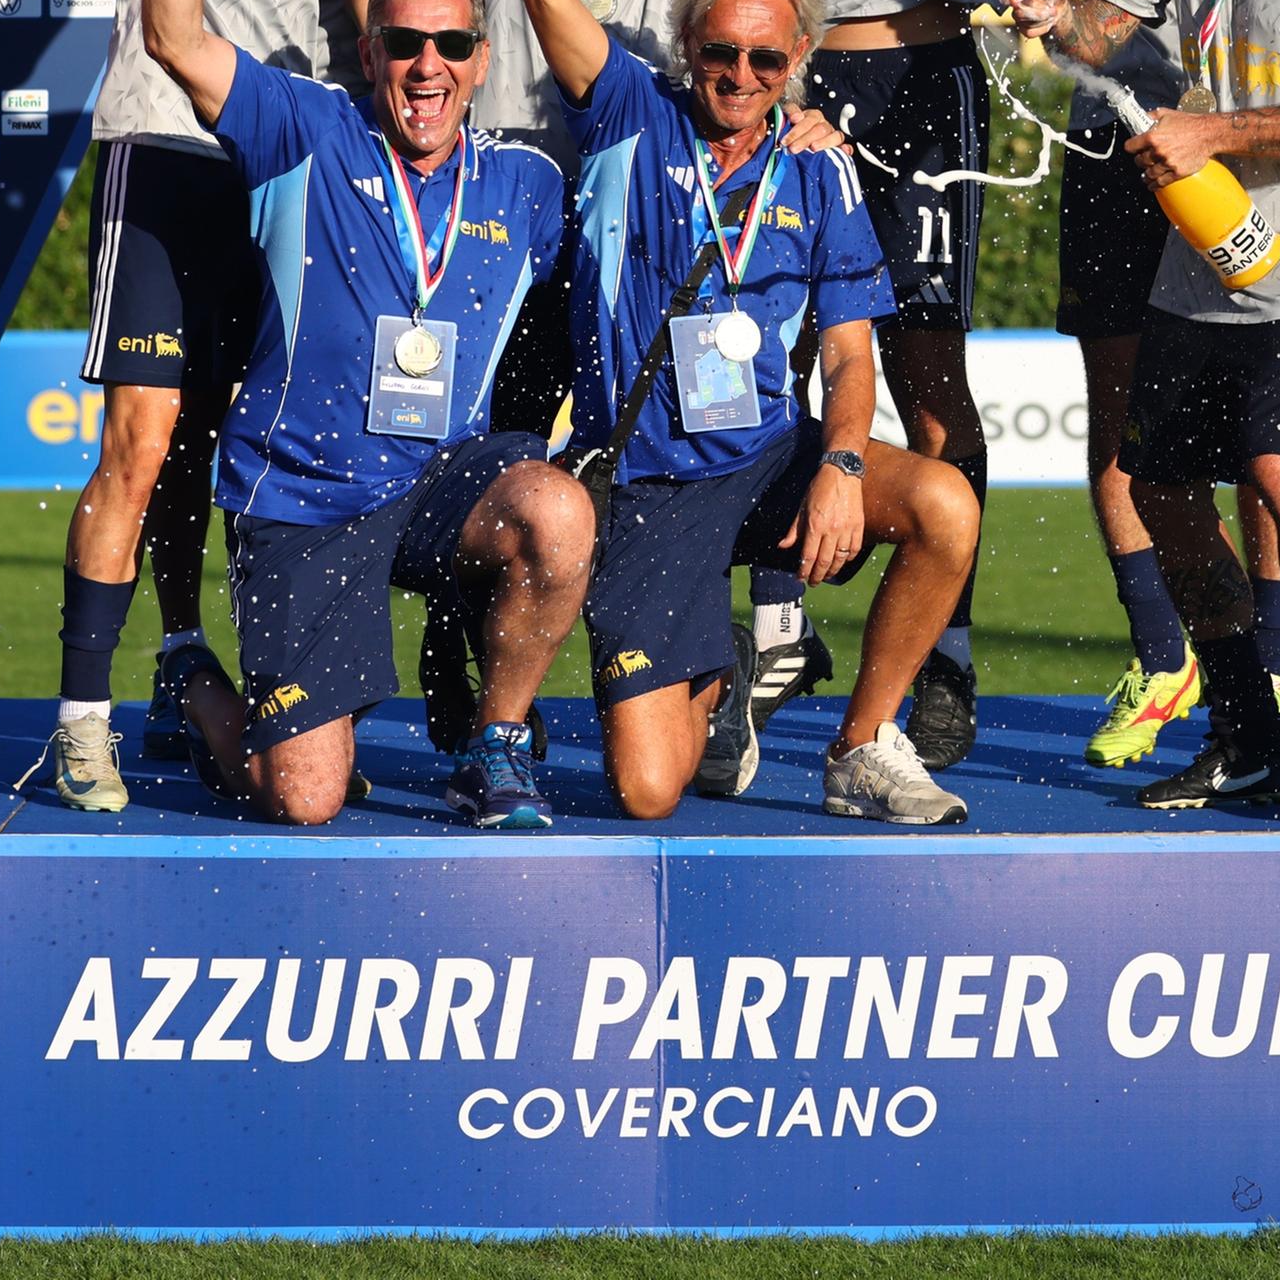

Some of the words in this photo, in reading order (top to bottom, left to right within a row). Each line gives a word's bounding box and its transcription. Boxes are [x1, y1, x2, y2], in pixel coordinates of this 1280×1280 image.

[8, 96, 42, 108] Fileni
[460, 220, 488, 241] eni
[916, 206, 953, 264] 11
[118, 334, 153, 354] eni
[45, 957, 534, 1062] AZZURRI
[572, 955, 1068, 1060] PARTNER
[457, 1086, 938, 1140] COVERCIANO
